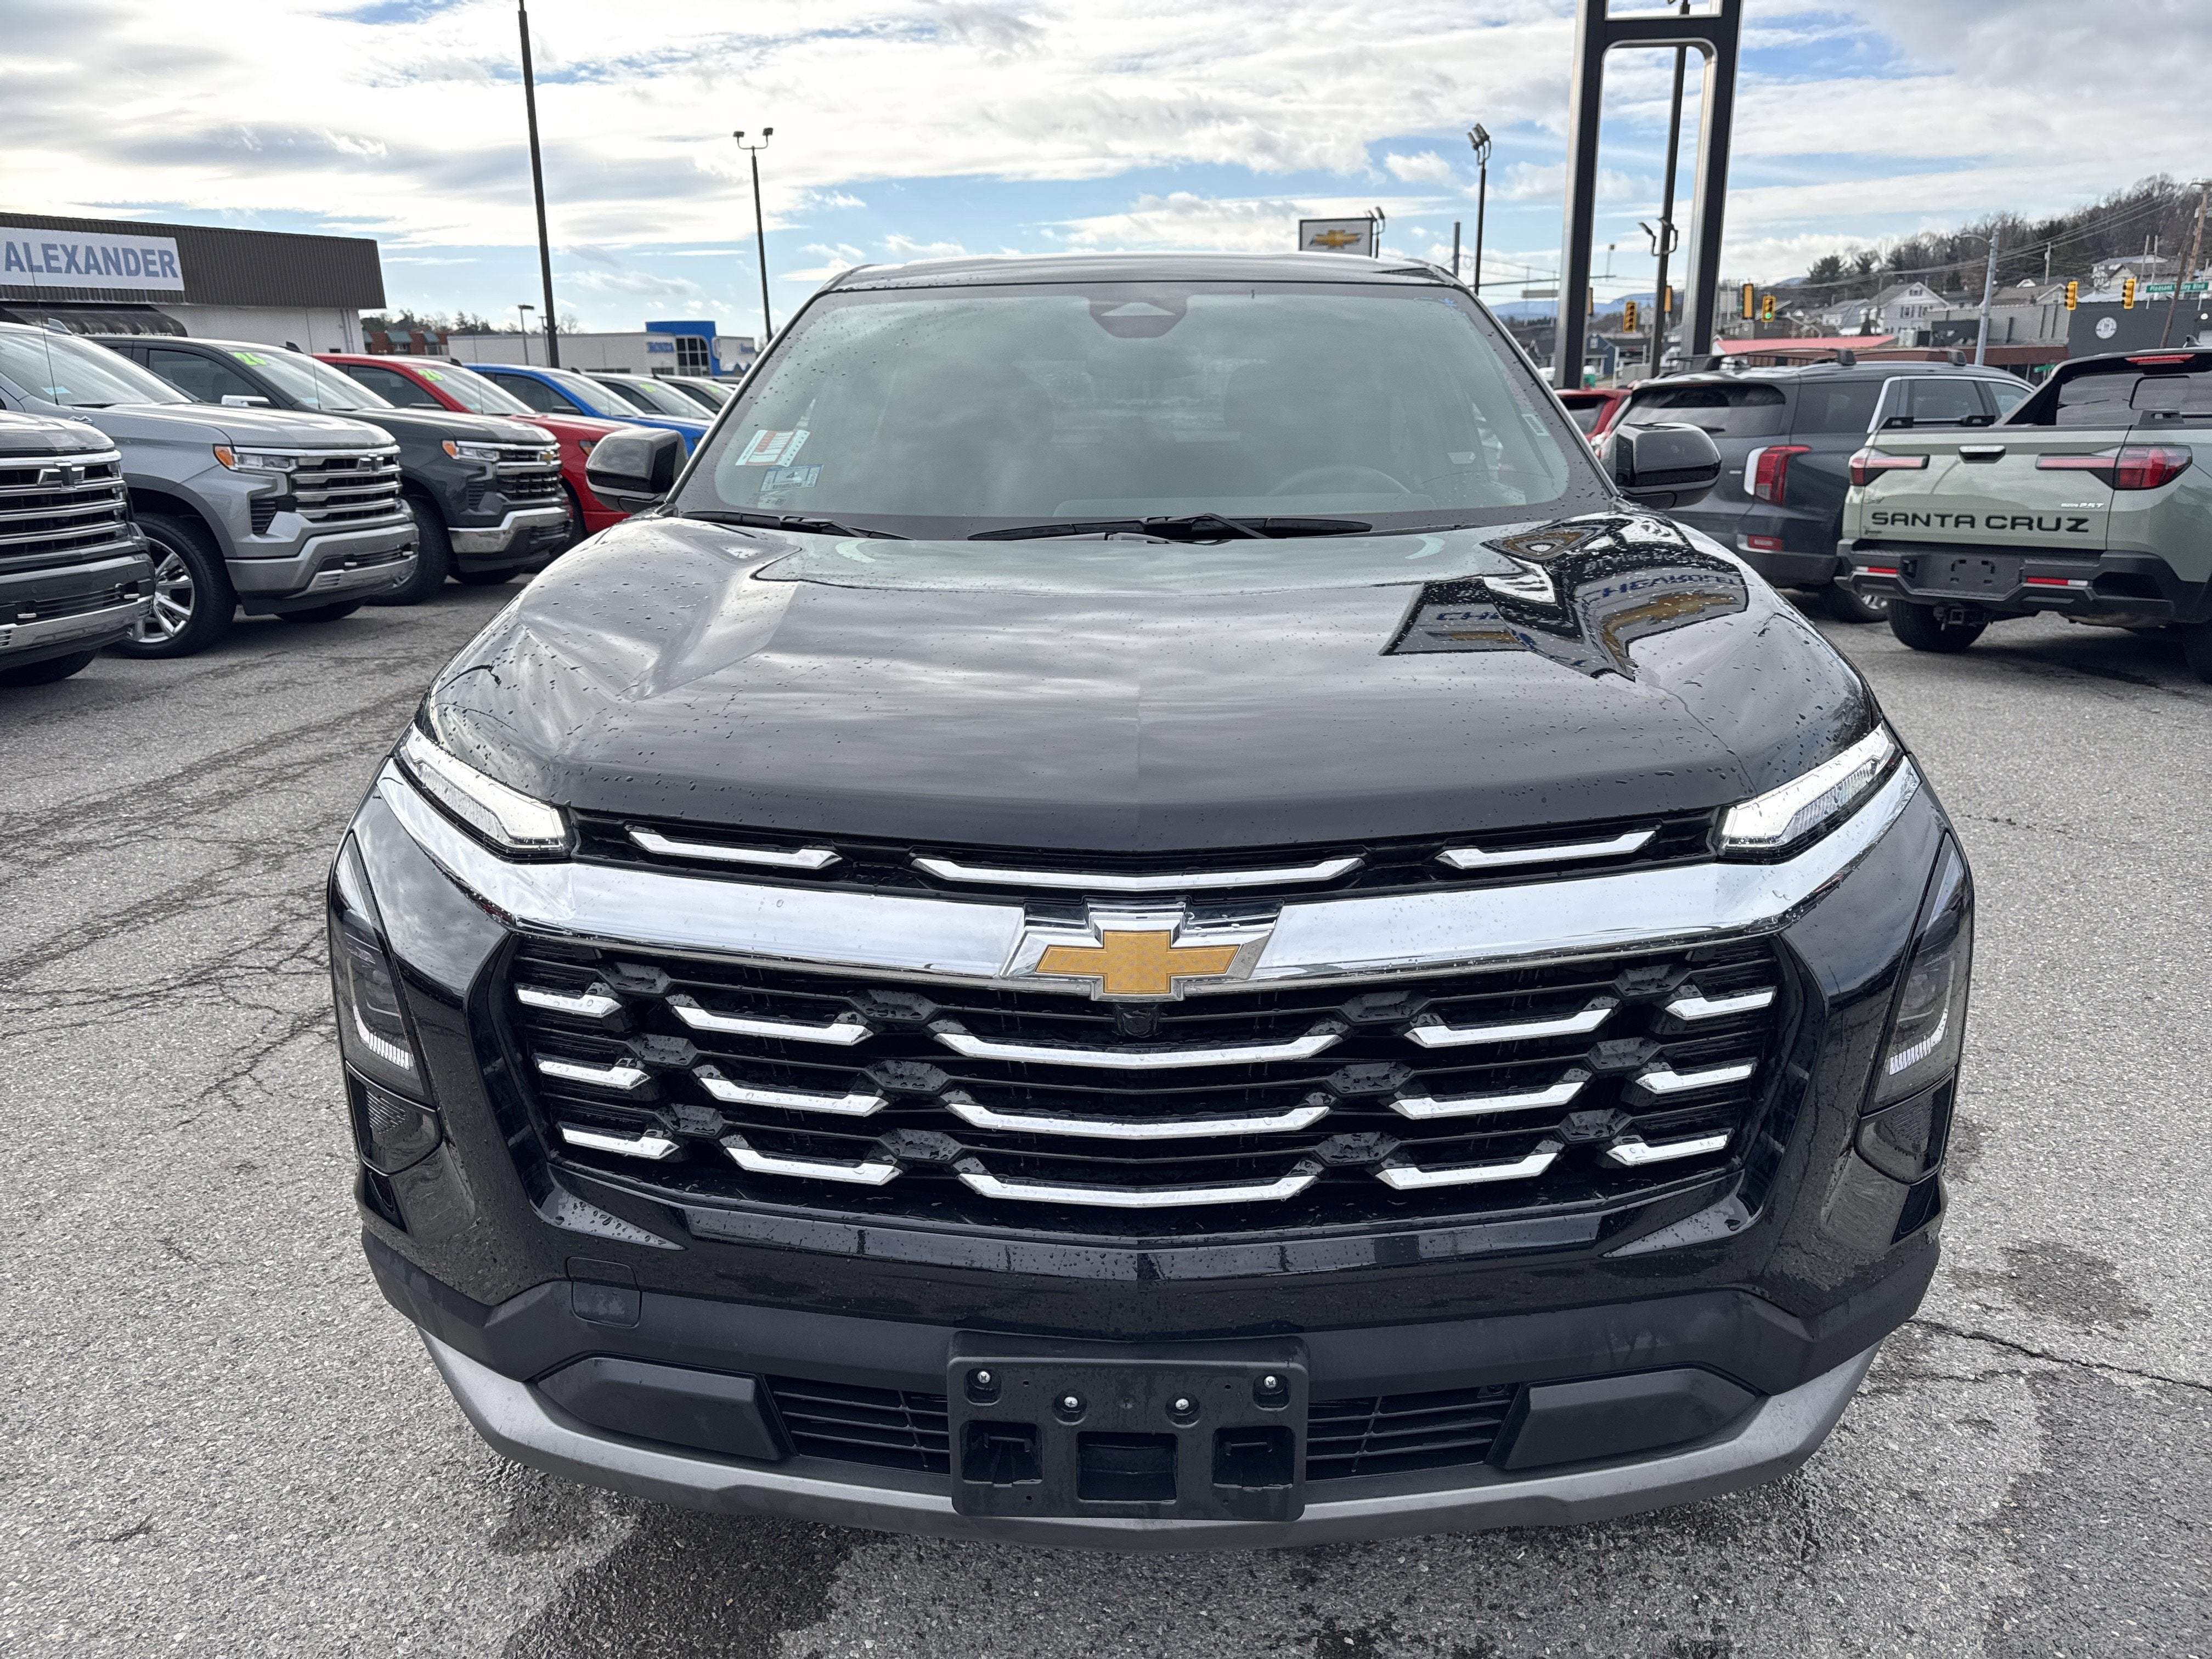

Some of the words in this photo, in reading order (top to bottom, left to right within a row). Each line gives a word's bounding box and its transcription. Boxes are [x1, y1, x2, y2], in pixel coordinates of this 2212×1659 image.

[5, 241, 178, 278] ALEXANDER
[1871, 511, 1976, 528] SANTA
[1985, 515, 2089, 533] CRUZ
